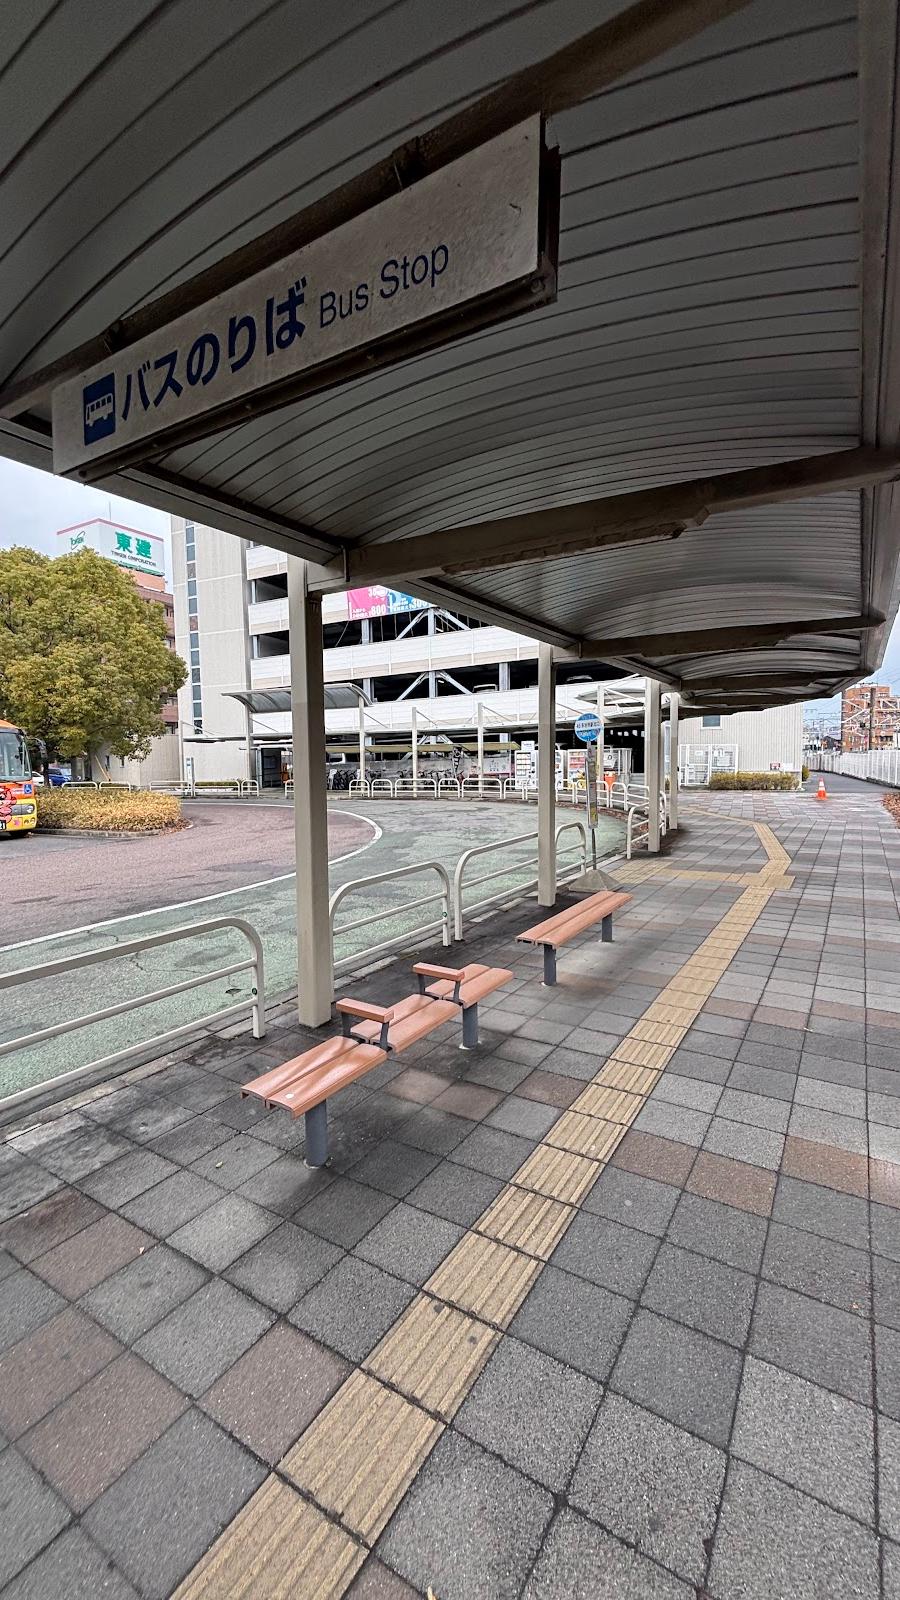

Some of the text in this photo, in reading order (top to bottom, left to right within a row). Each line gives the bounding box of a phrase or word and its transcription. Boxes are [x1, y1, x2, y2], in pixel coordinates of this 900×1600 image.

[121, 243, 450, 421] バスのりば Bus Stop
[115, 531, 152, 559] 東建
